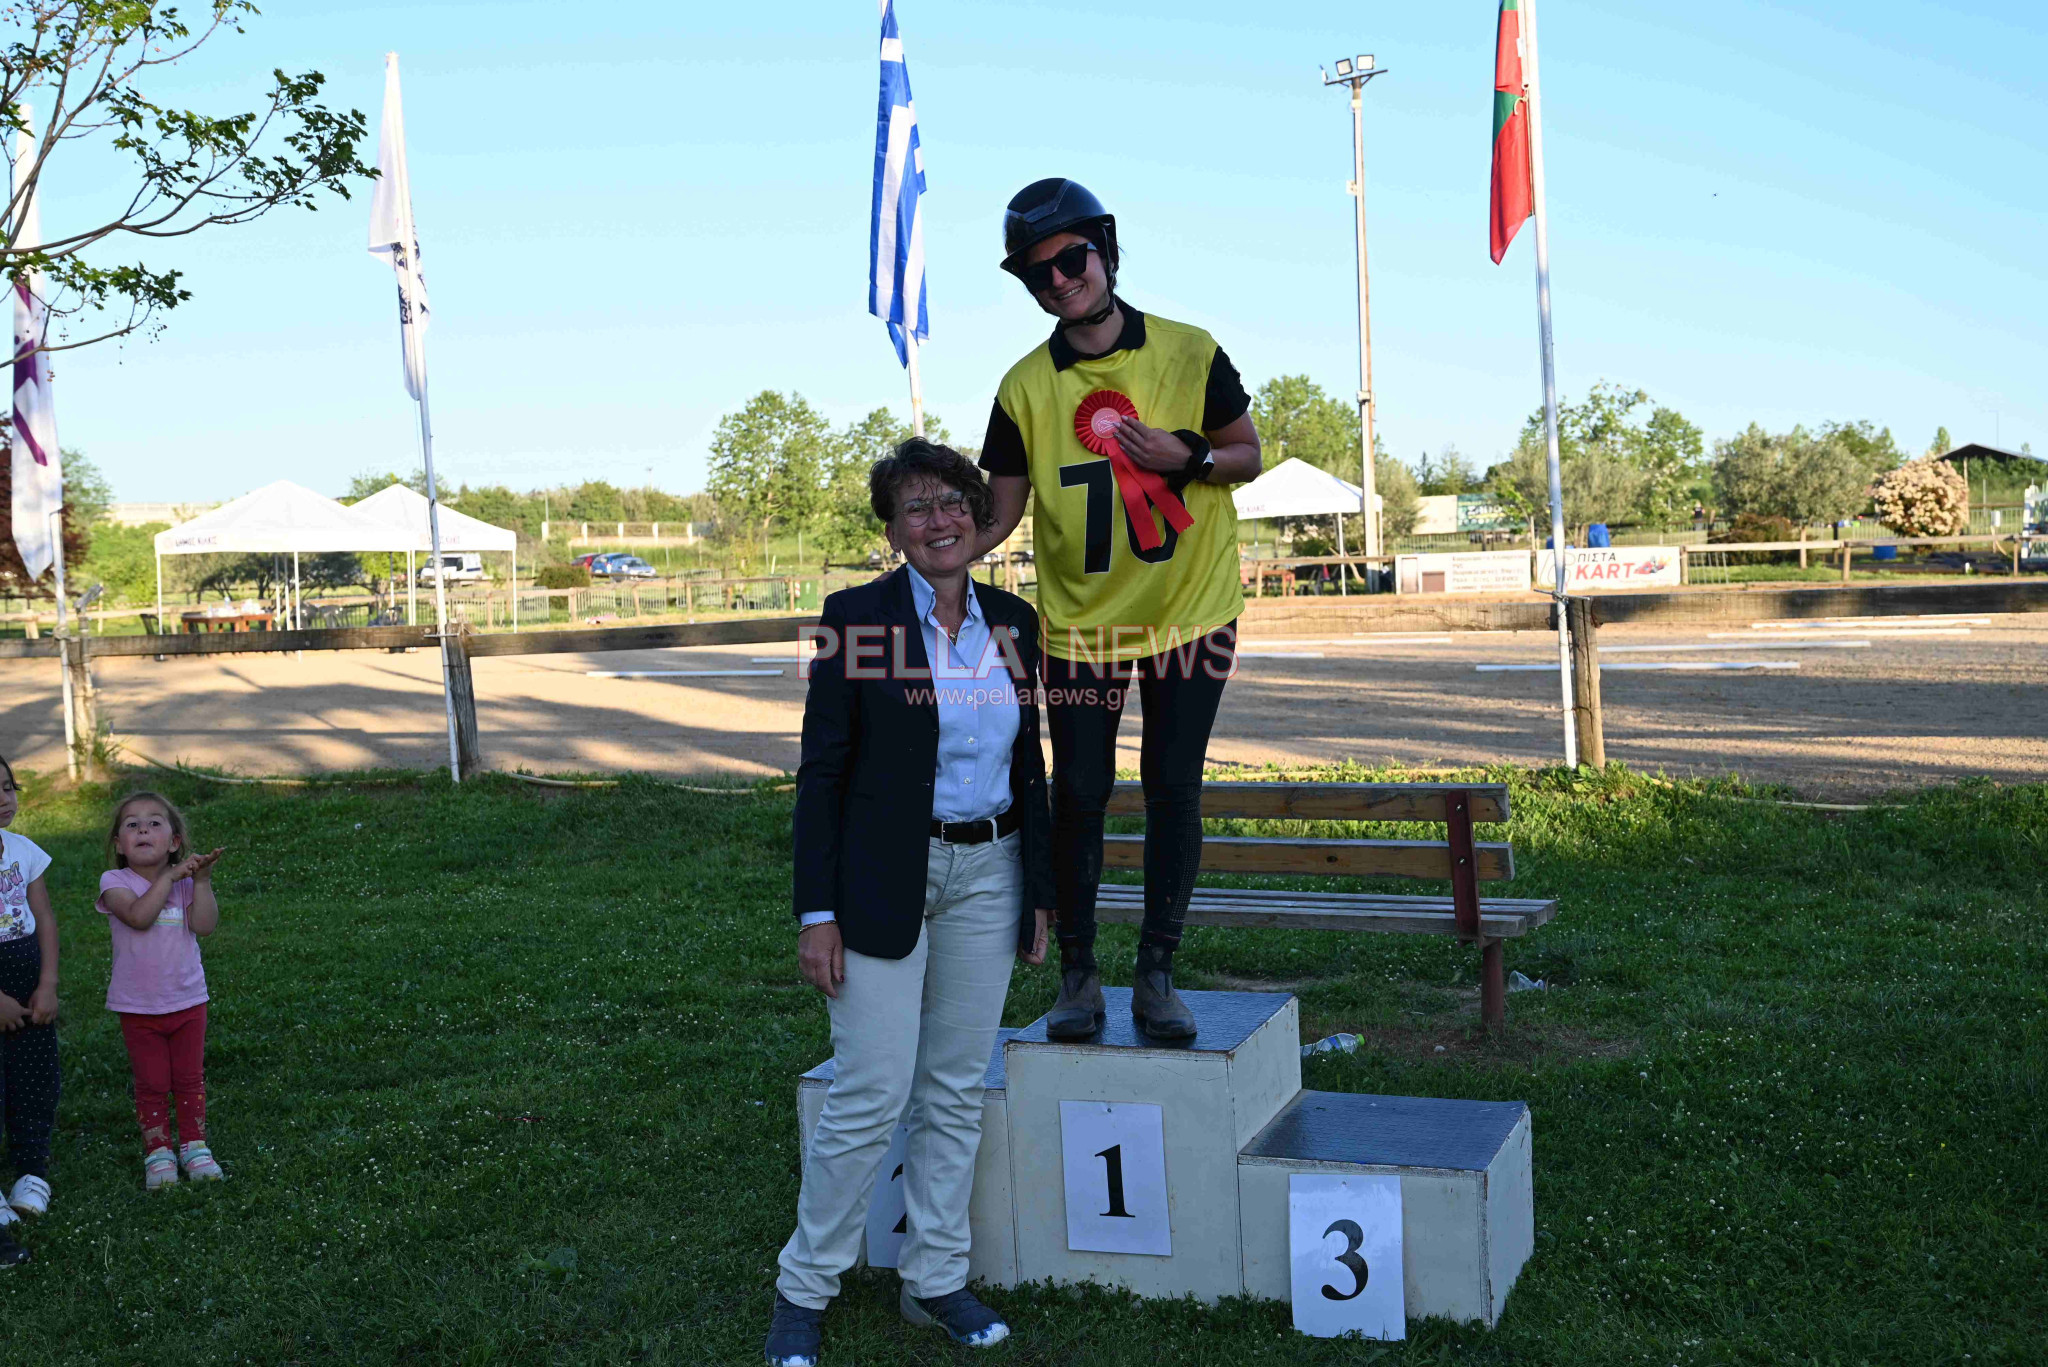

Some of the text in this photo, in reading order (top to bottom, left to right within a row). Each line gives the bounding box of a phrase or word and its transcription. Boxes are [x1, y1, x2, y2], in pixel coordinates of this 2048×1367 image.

[1575, 563, 1635, 580] KART
[1577, 552, 1616, 563] ΠΙΣΤΑ
[1094, 1144, 1136, 1218] 1
[1321, 1218, 1369, 1300] 3
